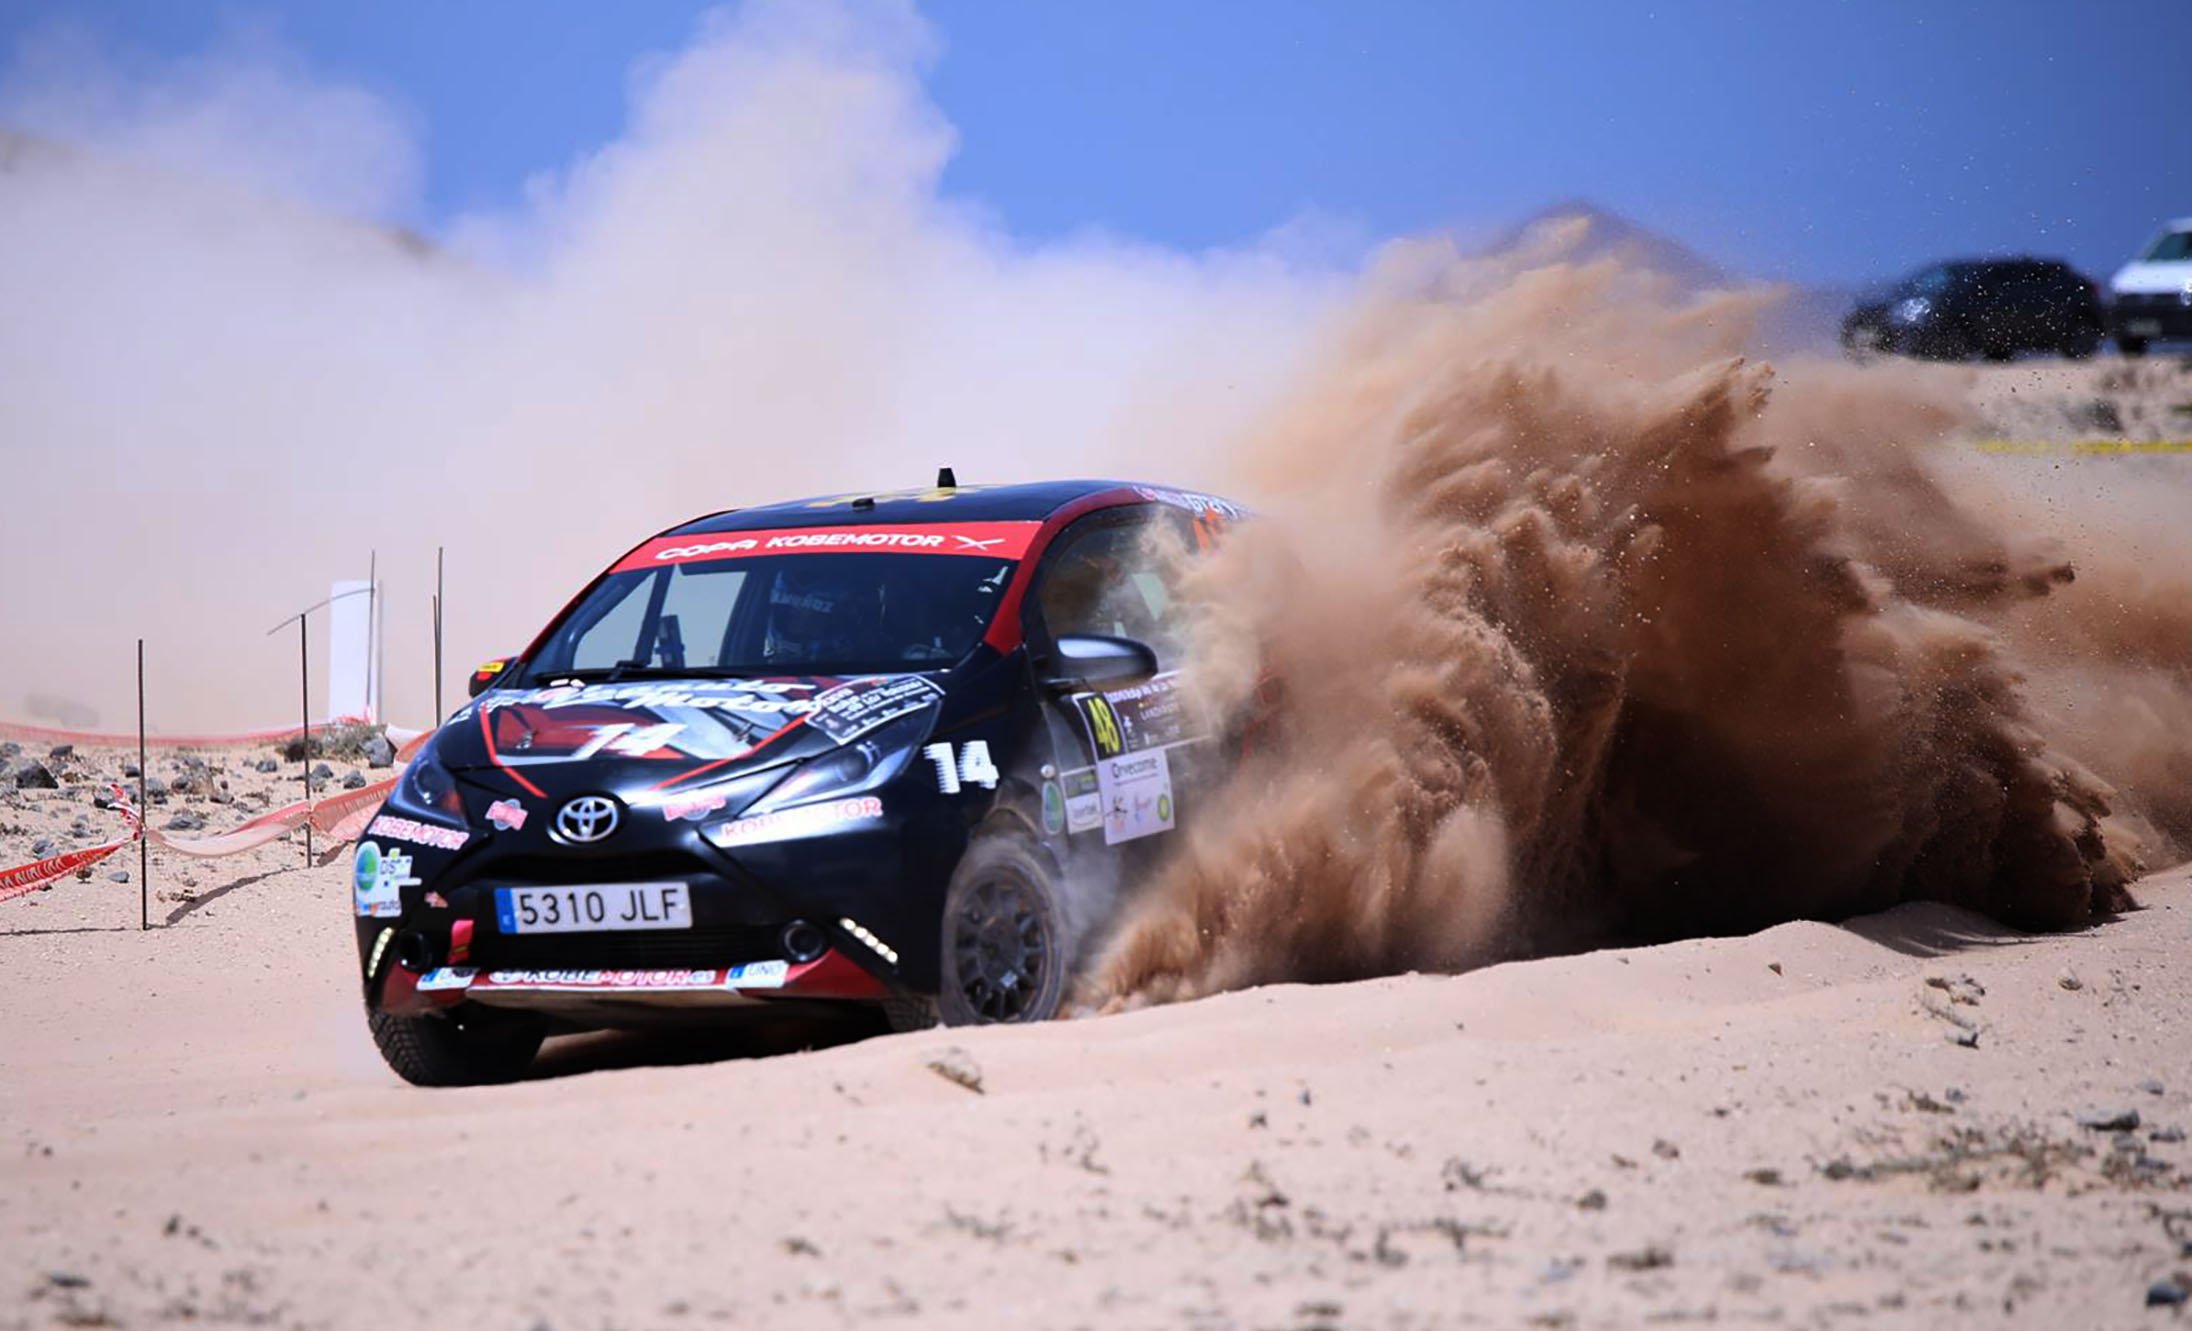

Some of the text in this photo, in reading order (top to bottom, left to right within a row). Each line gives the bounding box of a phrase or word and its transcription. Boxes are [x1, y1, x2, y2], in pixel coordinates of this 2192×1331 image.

[656, 540, 757, 561] COPA
[766, 534, 945, 550] KOBEMOTOR
[573, 722, 688, 758] 14
[1087, 697, 1121, 755] 48
[923, 740, 1000, 794] 14
[369, 815, 470, 850] KOBEMOTOR
[723, 798, 882, 836] KOOTOR
[518, 891, 605, 926] 5310
[620, 889, 678, 922] JLF
